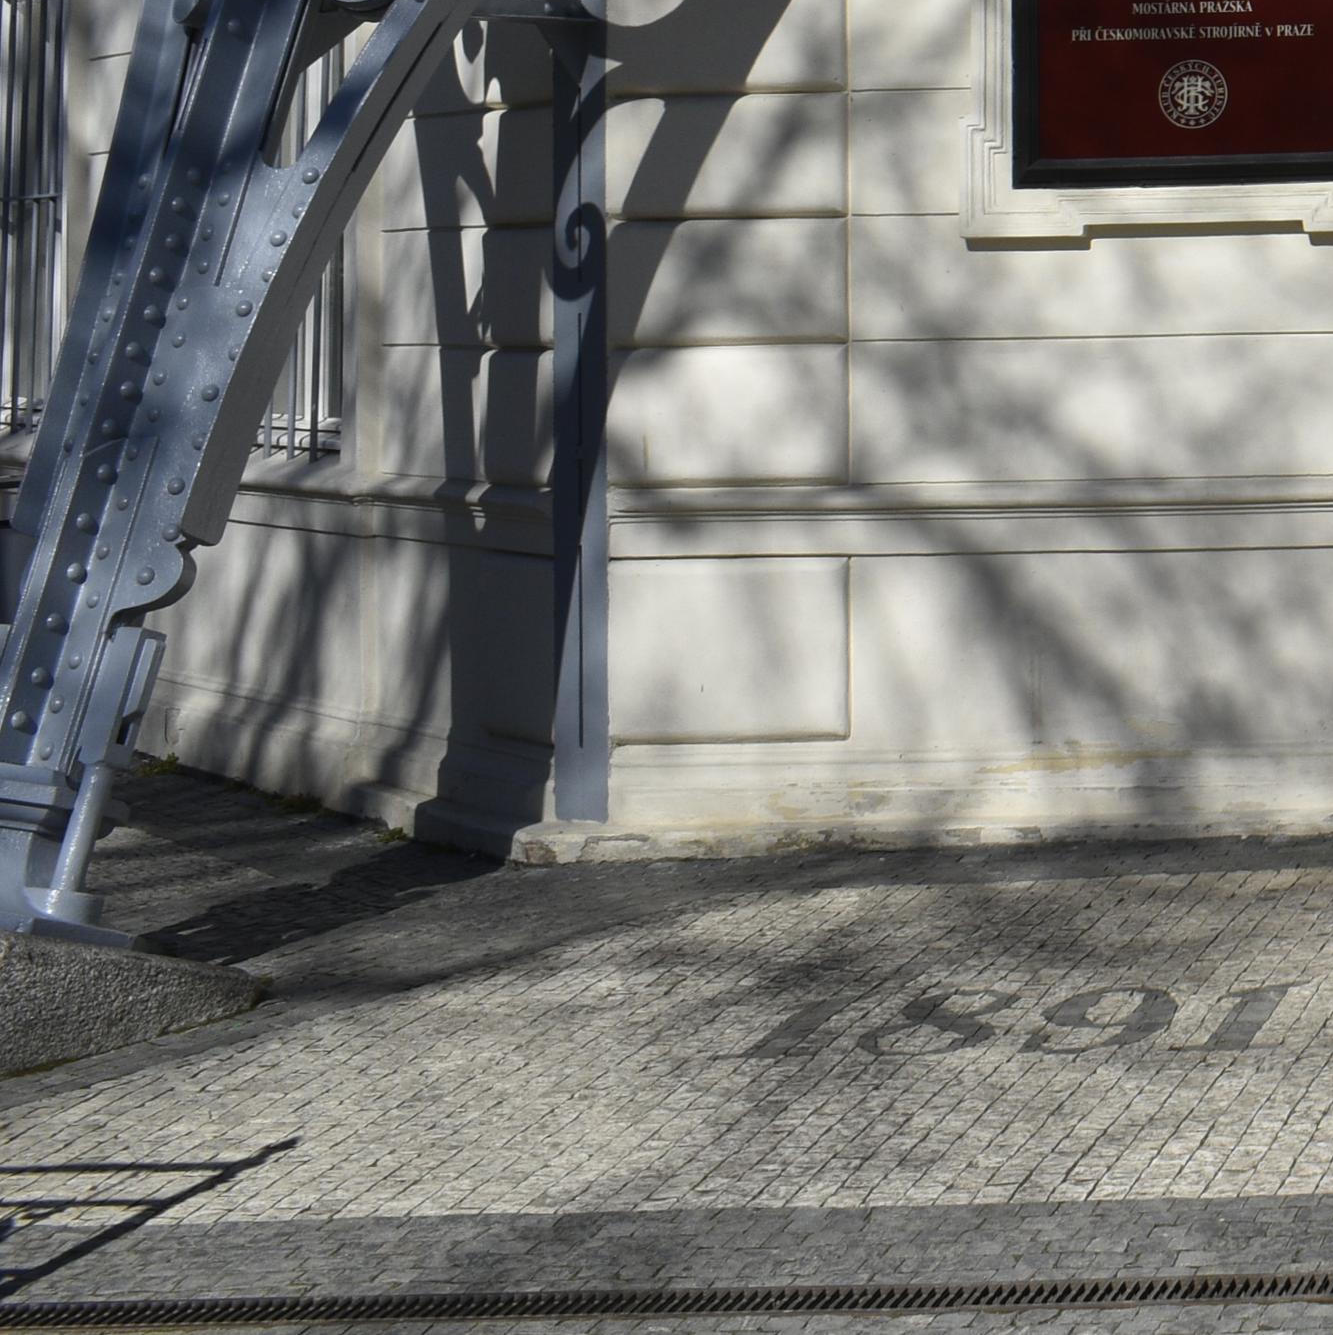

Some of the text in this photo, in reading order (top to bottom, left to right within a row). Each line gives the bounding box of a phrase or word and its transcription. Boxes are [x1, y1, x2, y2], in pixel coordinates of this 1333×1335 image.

[1071, 27, 1092, 41] PŘI
[1095, 25, 1196, 41] ČESKOMORAVSKÉ
[1200, 23, 1262, 39] STROJÍRNĚ
[1277, 24, 1315, 37] PRAZE
[715, 981, 1316, 1059] 1891
